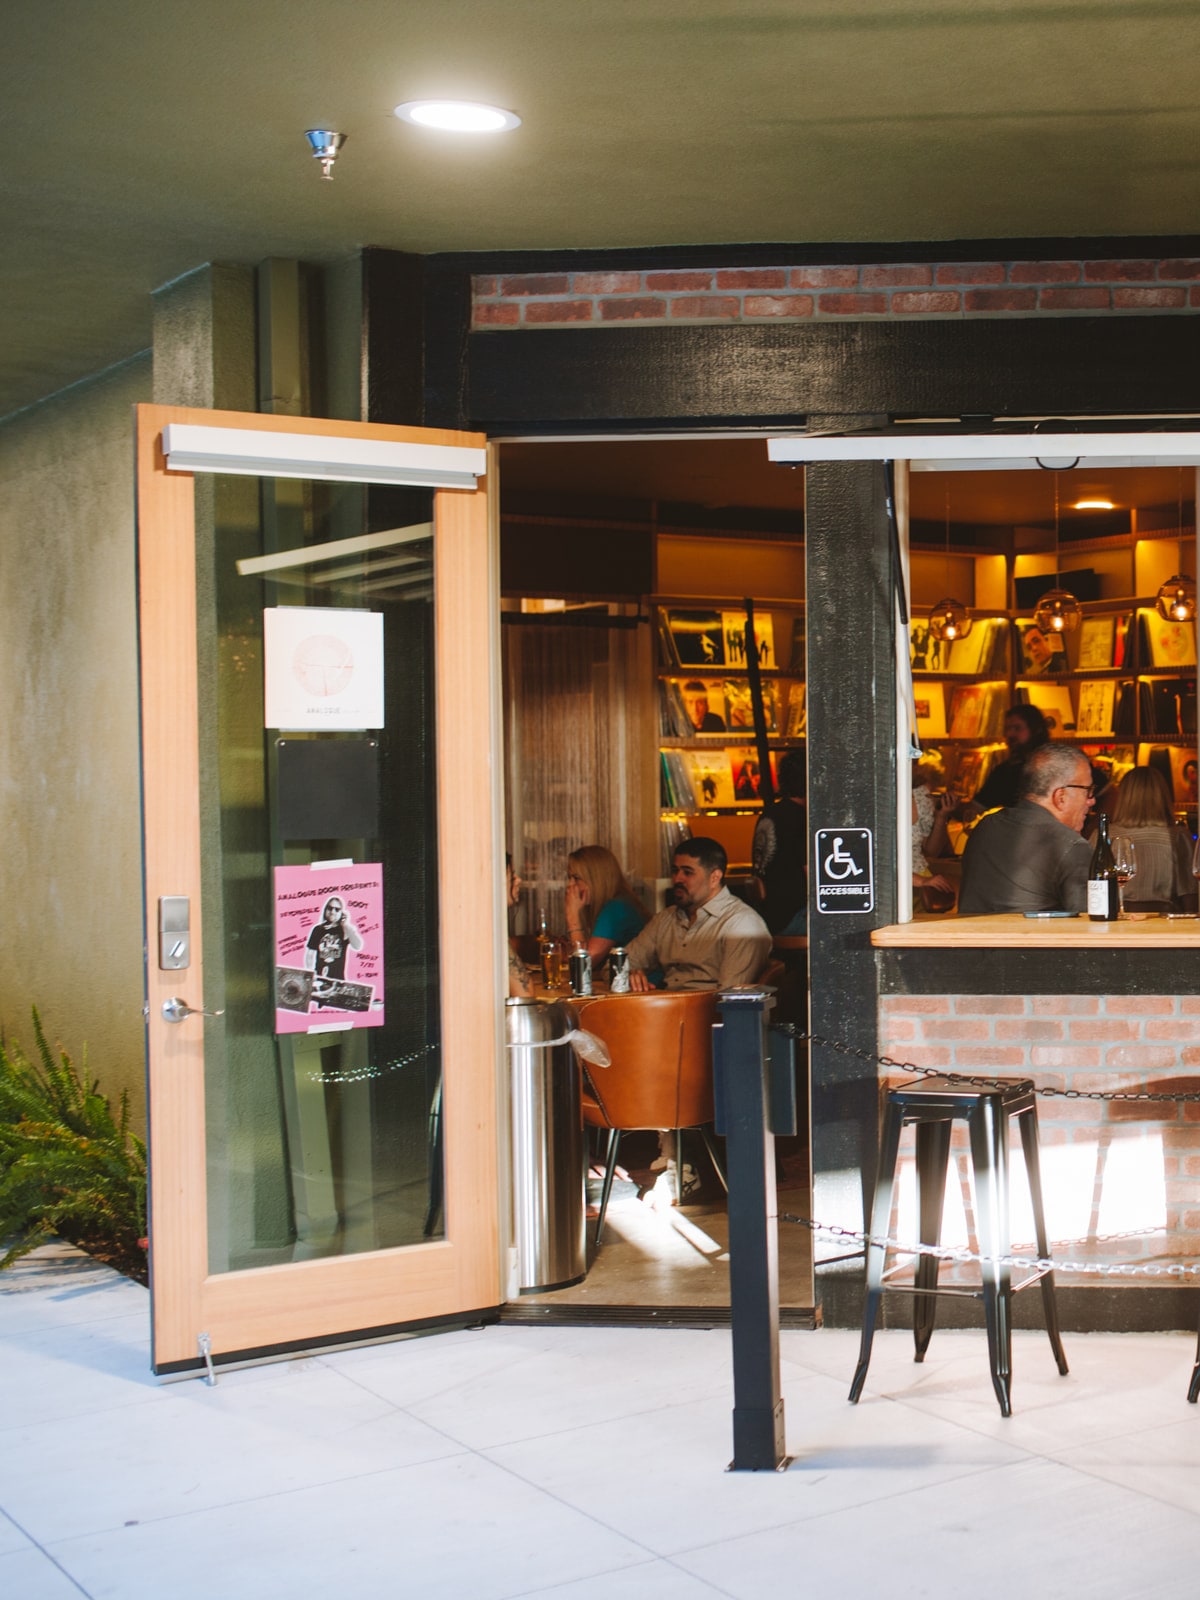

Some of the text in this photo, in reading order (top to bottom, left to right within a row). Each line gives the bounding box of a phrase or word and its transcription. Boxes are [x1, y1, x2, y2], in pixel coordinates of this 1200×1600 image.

[278, 891, 316, 900] ANALOGUE
[318, 886, 339, 895] ROOM
[819, 887, 870, 896] ACCESSIBLE
